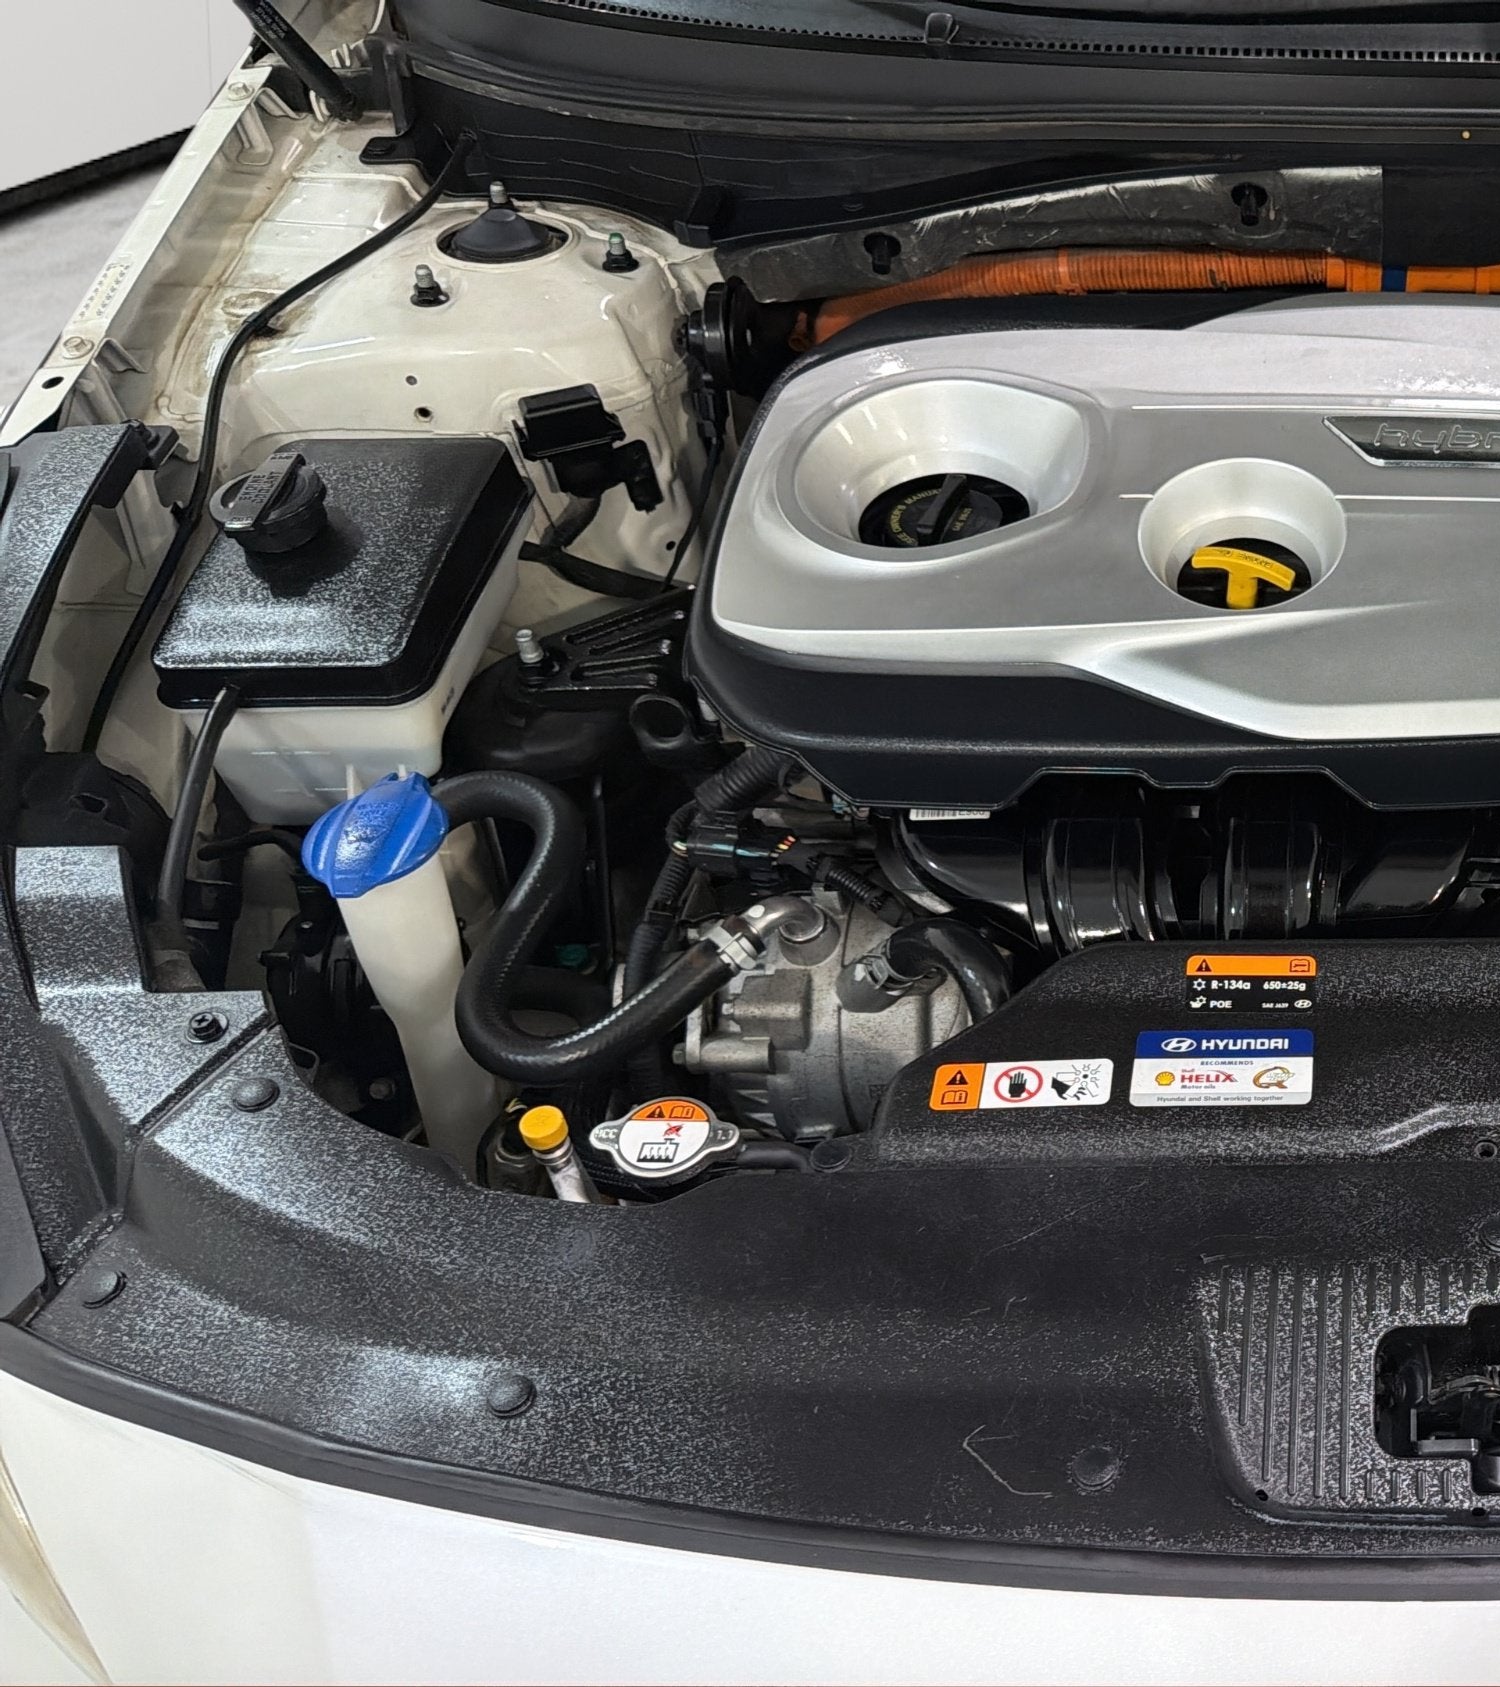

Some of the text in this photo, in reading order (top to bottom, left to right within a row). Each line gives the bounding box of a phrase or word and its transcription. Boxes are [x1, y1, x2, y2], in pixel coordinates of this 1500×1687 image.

[1210, 980, 1307, 991] R-134a 650±25g
[1209, 1000, 1233, 1008] POE
[1201, 1038, 1289, 1050] HYUNDAI
[1180, 1074, 1238, 1083] HELIX
